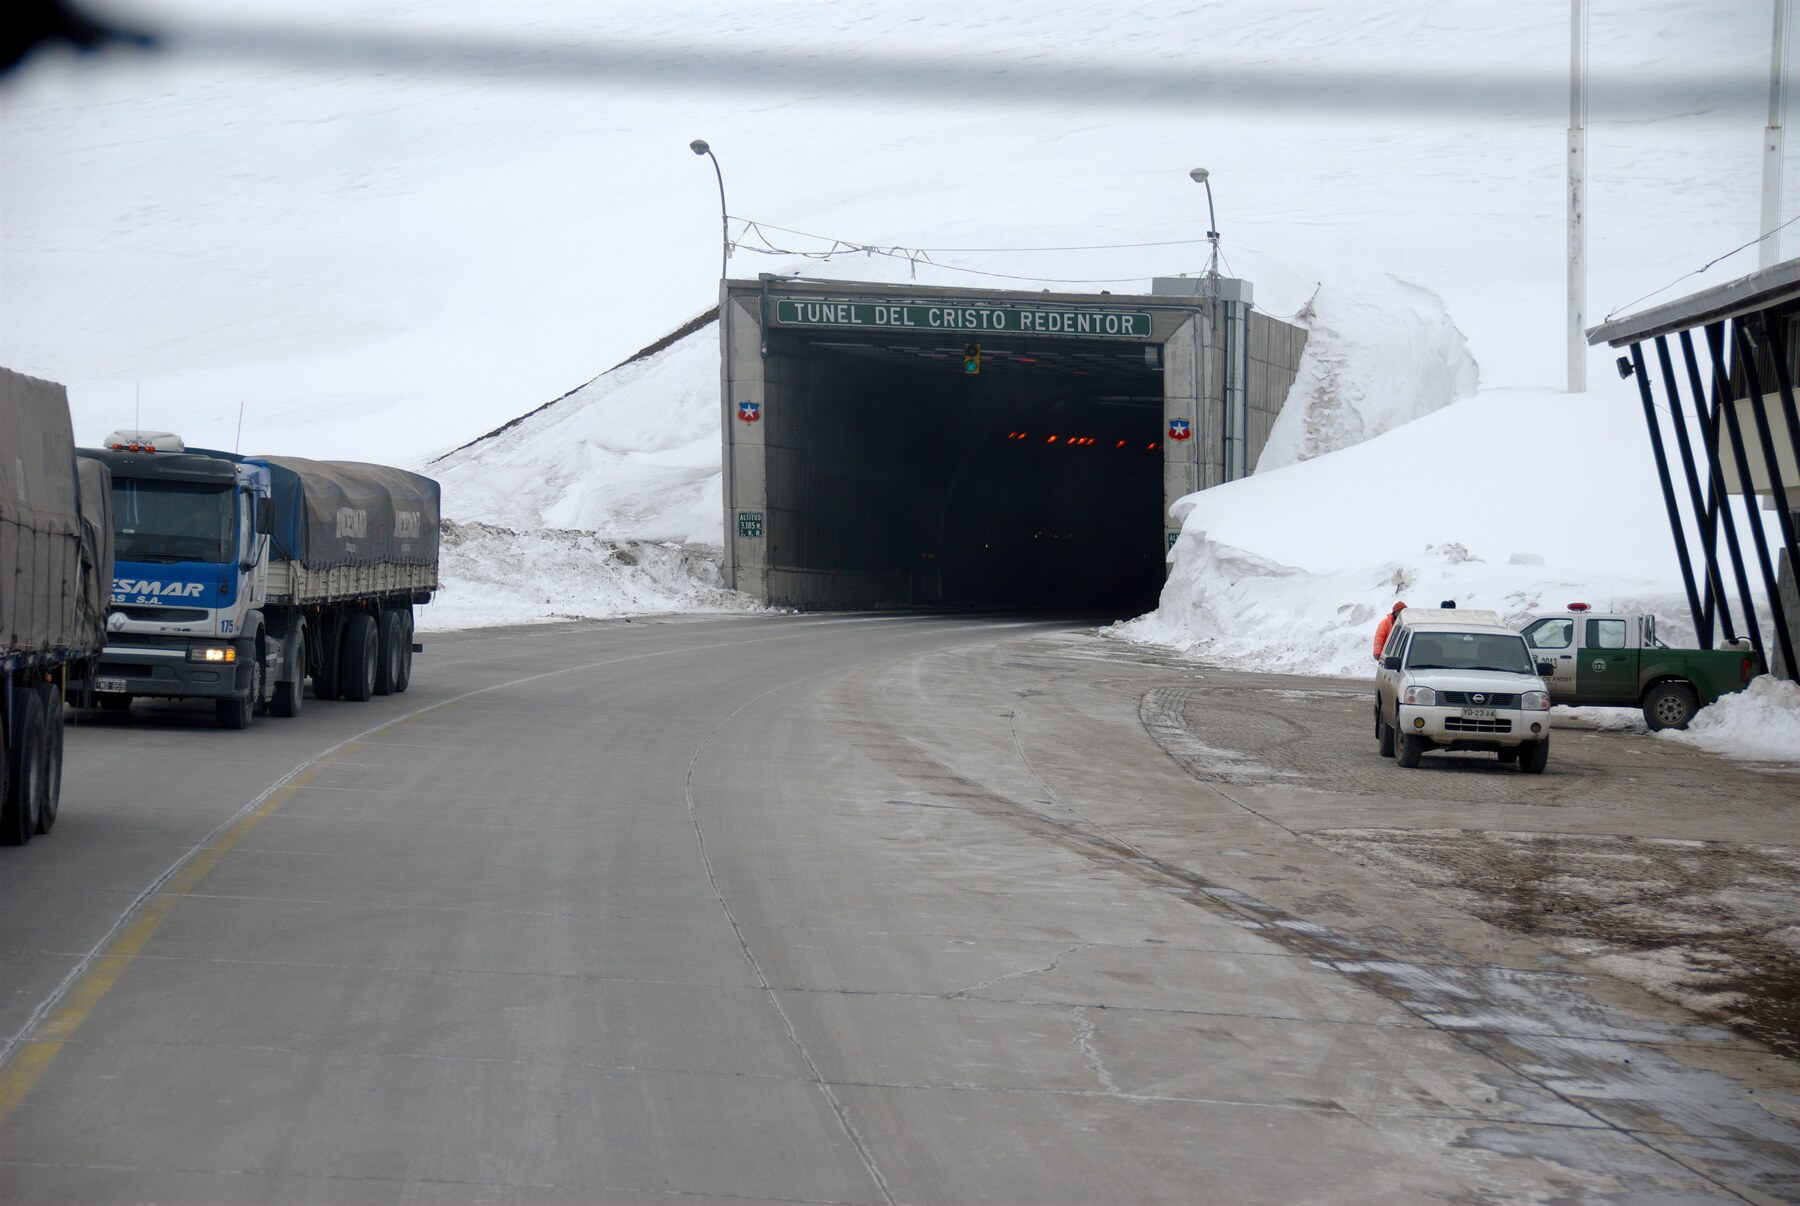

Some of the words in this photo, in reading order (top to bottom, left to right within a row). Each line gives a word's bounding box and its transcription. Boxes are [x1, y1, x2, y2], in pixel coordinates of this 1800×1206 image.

[794, 303, 862, 324] TUNEL
[875, 306, 914, 326] DEL
[929, 308, 1006, 330] CRISTO
[1020, 311, 1134, 334] REDENTOR
[740, 521, 756, 530] 3.185
[136, 595, 163, 605] S.A.
[221, 619, 234, 633] 175
